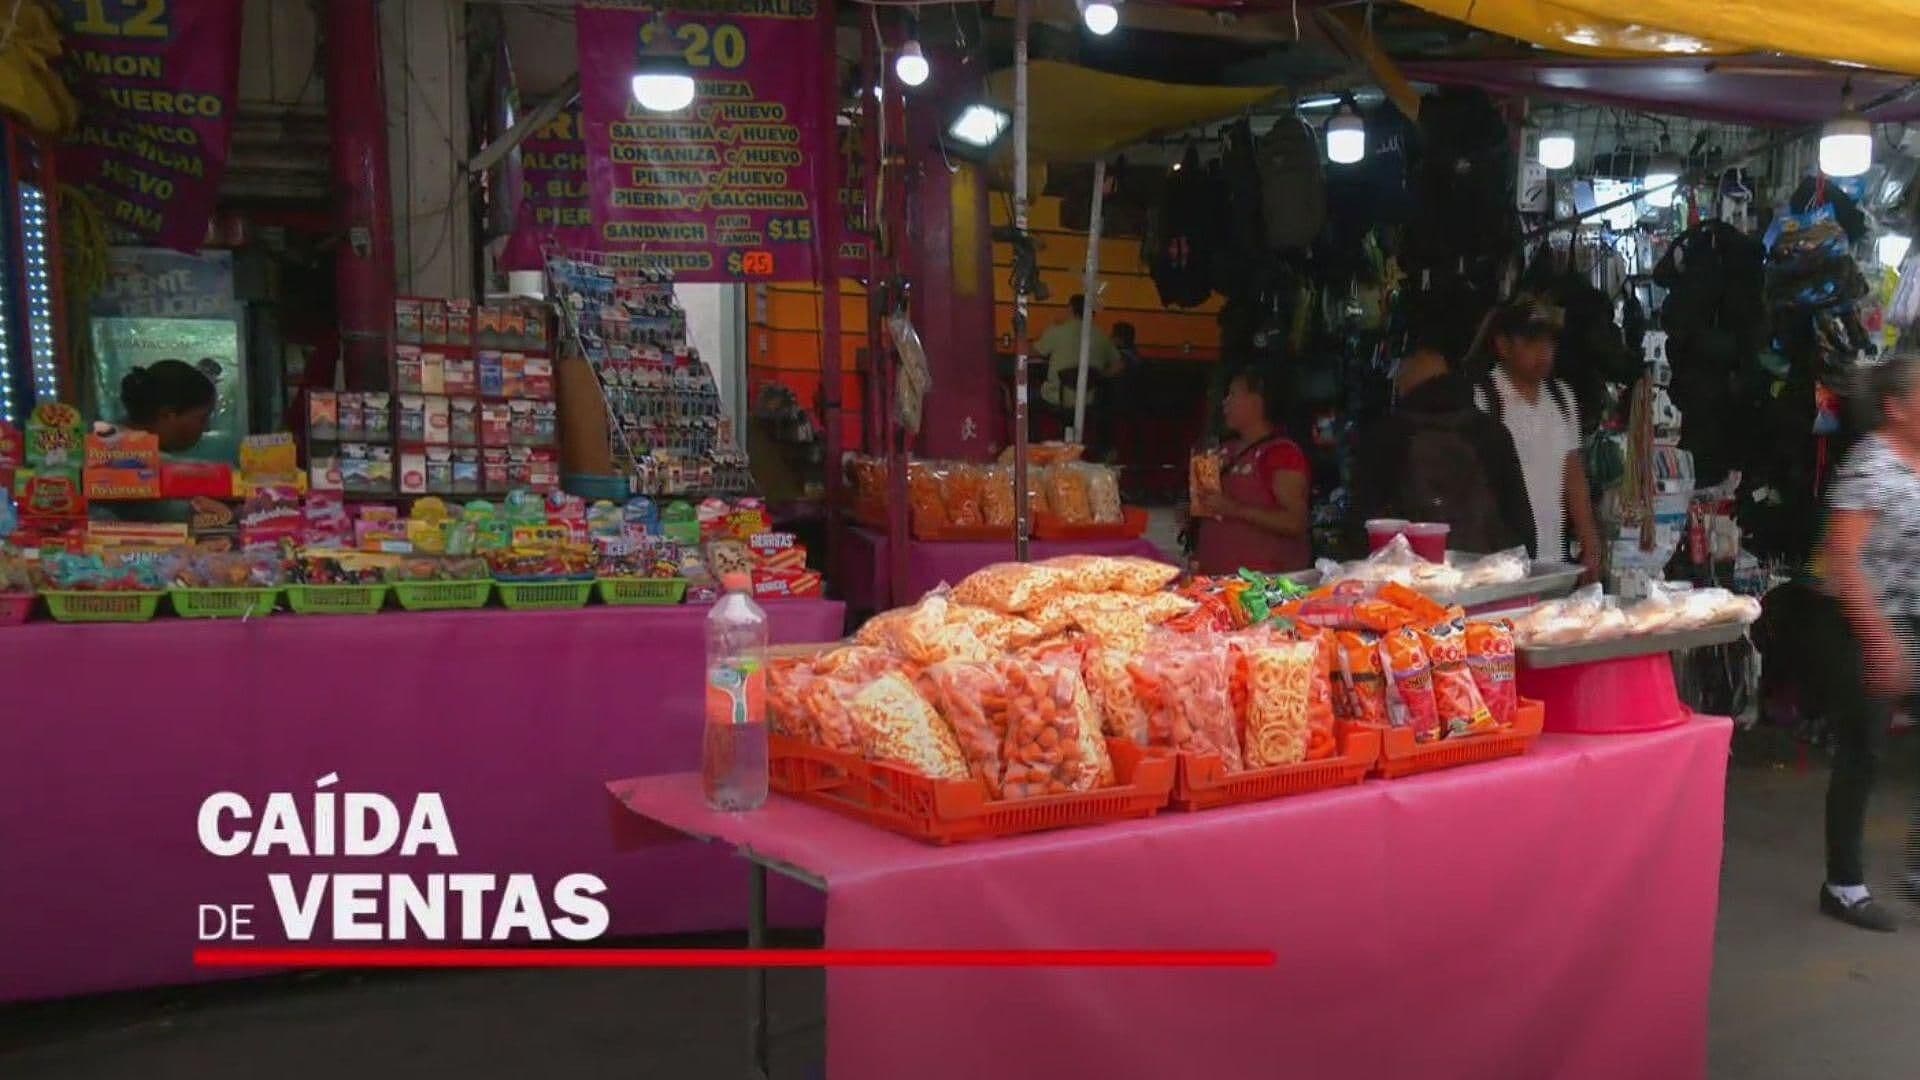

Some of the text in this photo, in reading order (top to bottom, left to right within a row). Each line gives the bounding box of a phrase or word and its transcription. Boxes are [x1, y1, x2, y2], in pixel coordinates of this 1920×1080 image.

[108, 88, 222, 117] UERCO
[724, 104, 784, 120] HUEVO
[612, 124, 715, 140] SALCHICHA
[743, 127, 799, 142] HUEVO
[612, 147, 718, 163] LONGANIZA
[745, 149, 800, 163] HUEVO
[634, 171, 704, 187] PIERNA
[727, 172, 785, 186] HUEVO
[614, 192, 682, 207] PIERNA
[710, 193, 806, 208] SALCHICHA
[536, 206, 593, 225] PIER
[605, 224, 706, 240] SANDWICH
[767, 219, 812, 242] $15
[717, 233, 762, 245] JAMON
